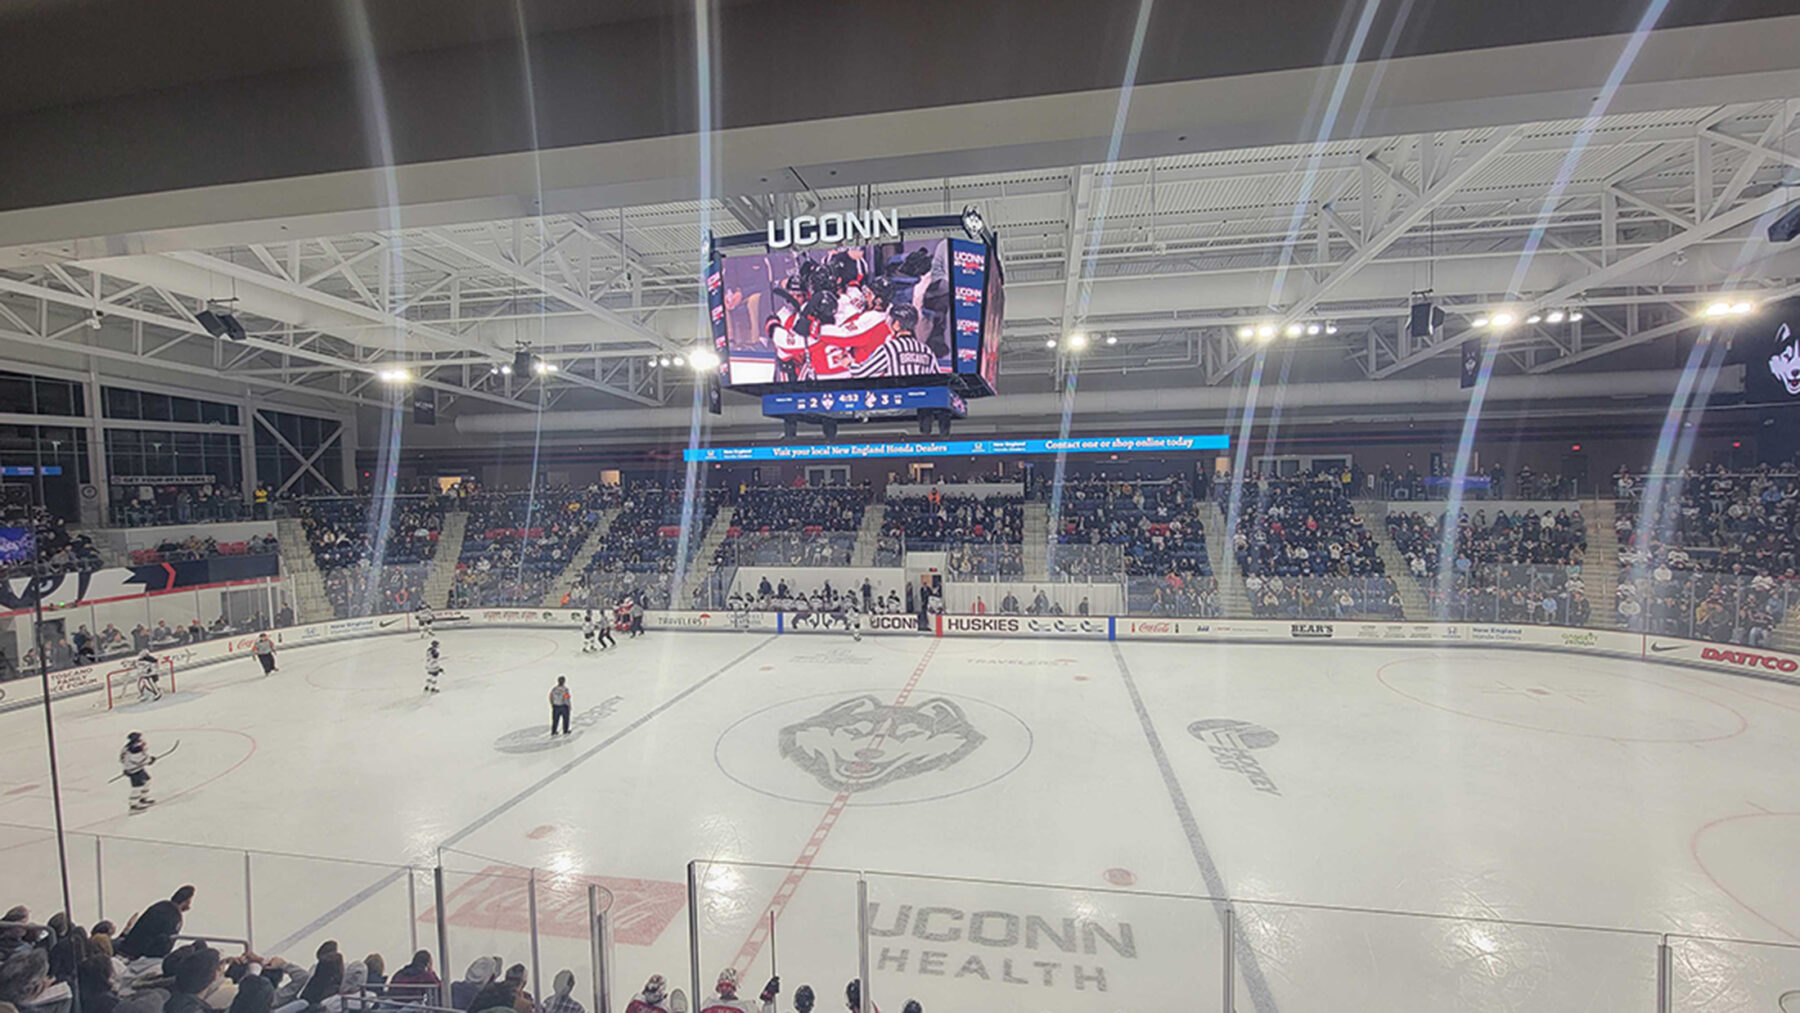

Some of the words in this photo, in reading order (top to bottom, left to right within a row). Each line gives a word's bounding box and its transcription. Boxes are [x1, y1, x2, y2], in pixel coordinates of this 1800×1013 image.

[767, 208, 898, 249] UCONN
[954, 251, 985, 264] UCONN
[955, 286, 982, 298] UCONN
[1045, 440, 1080, 449] Contact
[1112, 437, 1134, 450] shop
[1135, 437, 1165, 447] online
[1167, 436, 1193, 449] today
[773, 447, 790, 456] Visit
[792, 449, 809, 458] your
[811, 446, 830, 455] local
[832, 445, 849, 454] New
[851, 444, 885, 456] England
[886, 443, 914, 453] Honda
[916, 442, 947, 452] Dealers
[658, 617, 702, 625] TRAVELERS
[948, 618, 1019, 631] HUSKIES
[1138, 622, 1170, 634] Coca-Cola
[1291, 624, 1334, 634] BEAR'S
[1491, 627, 1522, 635] England
[1701, 648, 1799, 672] DATTCO
[51, 668, 93, 680] TOSCANO
[868, 901, 1138, 959] UCONN
[877, 947, 1108, 992] HEALTH
